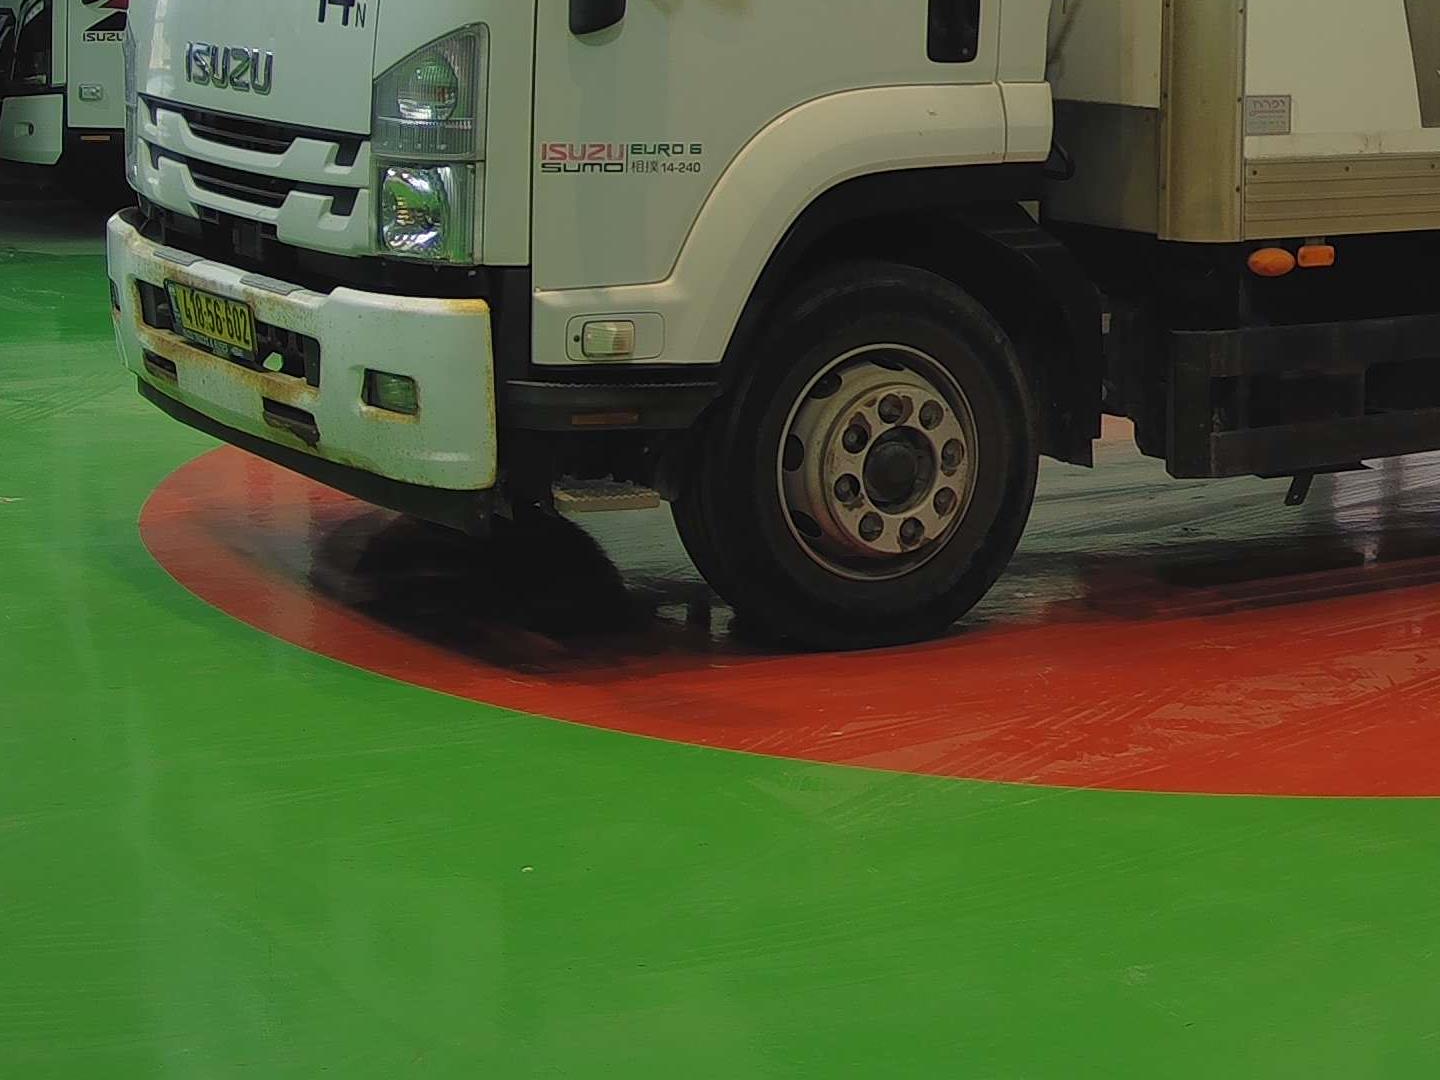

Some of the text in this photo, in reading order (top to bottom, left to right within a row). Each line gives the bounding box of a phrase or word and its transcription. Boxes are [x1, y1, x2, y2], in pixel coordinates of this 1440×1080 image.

[185, 41, 274, 96] ISUZU
[541, 143, 625, 161] ISUZU
[630, 143, 702, 157] EURO 6
[541, 162, 624, 173] SUMO
[661, 161, 702, 174] 14-240
